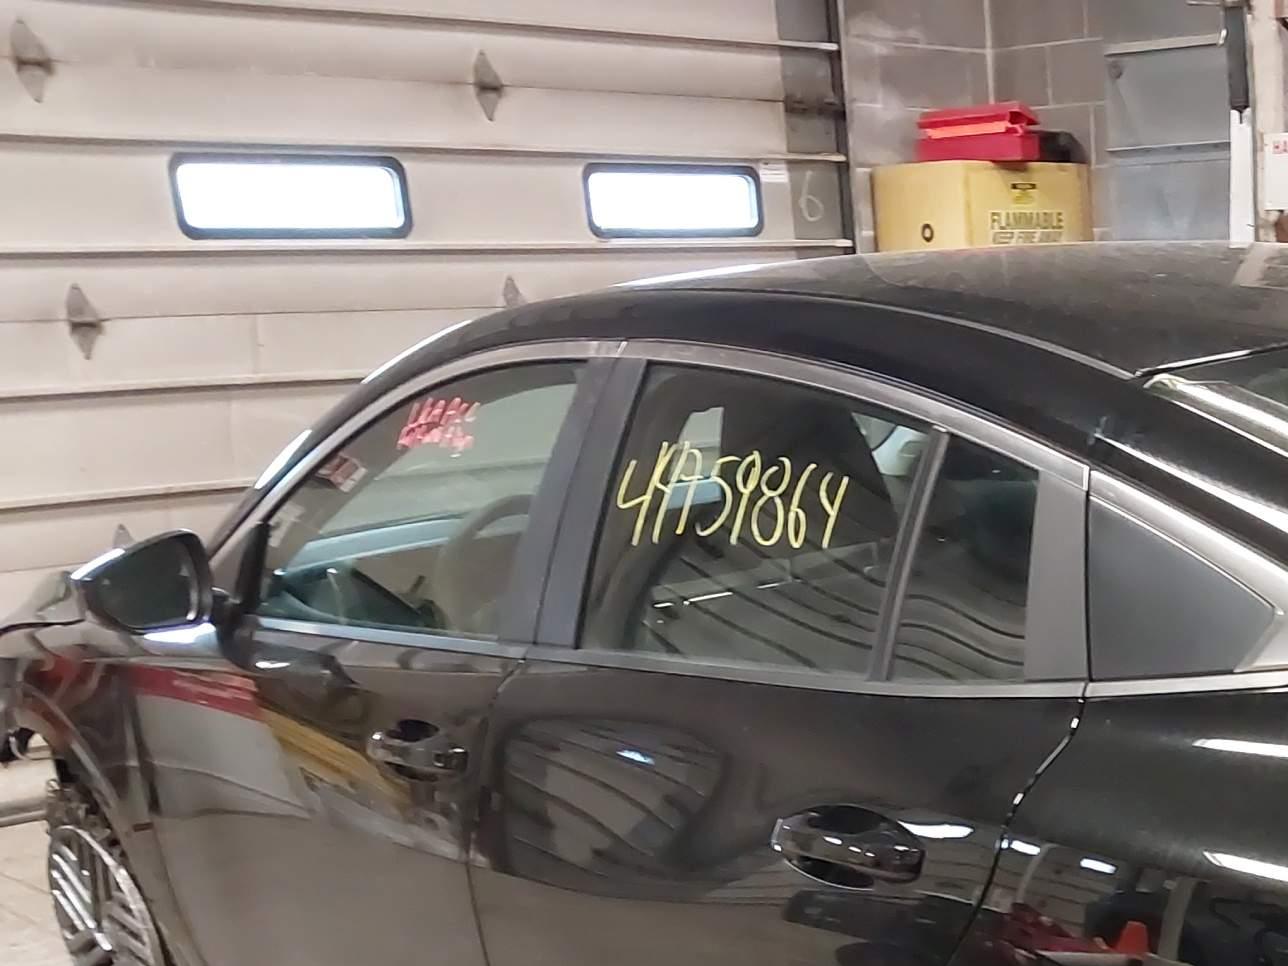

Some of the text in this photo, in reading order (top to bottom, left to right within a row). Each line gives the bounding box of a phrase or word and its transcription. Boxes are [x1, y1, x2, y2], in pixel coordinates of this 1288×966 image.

[798, 169, 825, 222] 6
[990, 211, 1064, 230] FLAMMABLE
[617, 440, 850, 549] 44759864
